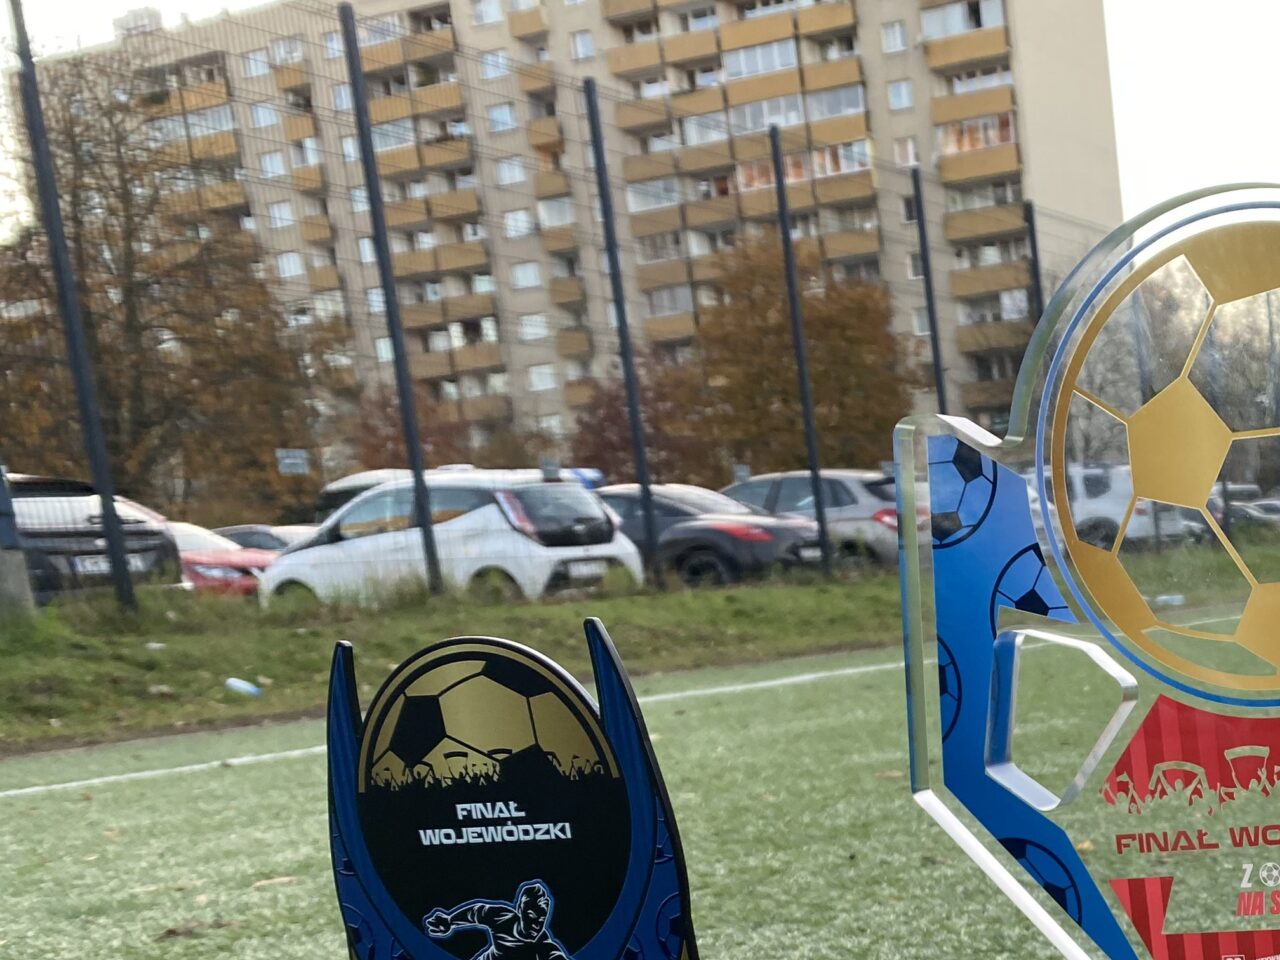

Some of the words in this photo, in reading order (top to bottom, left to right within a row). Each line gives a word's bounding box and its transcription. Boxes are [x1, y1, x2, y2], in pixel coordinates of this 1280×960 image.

[455, 801, 526, 820] FINAŁ
[418, 821, 572, 846] WOJEWÓDZKI
[1115, 829, 1220, 854] FINAŁ
[1240, 863, 1253, 888] Z
[1236, 891, 1264, 917] NA
